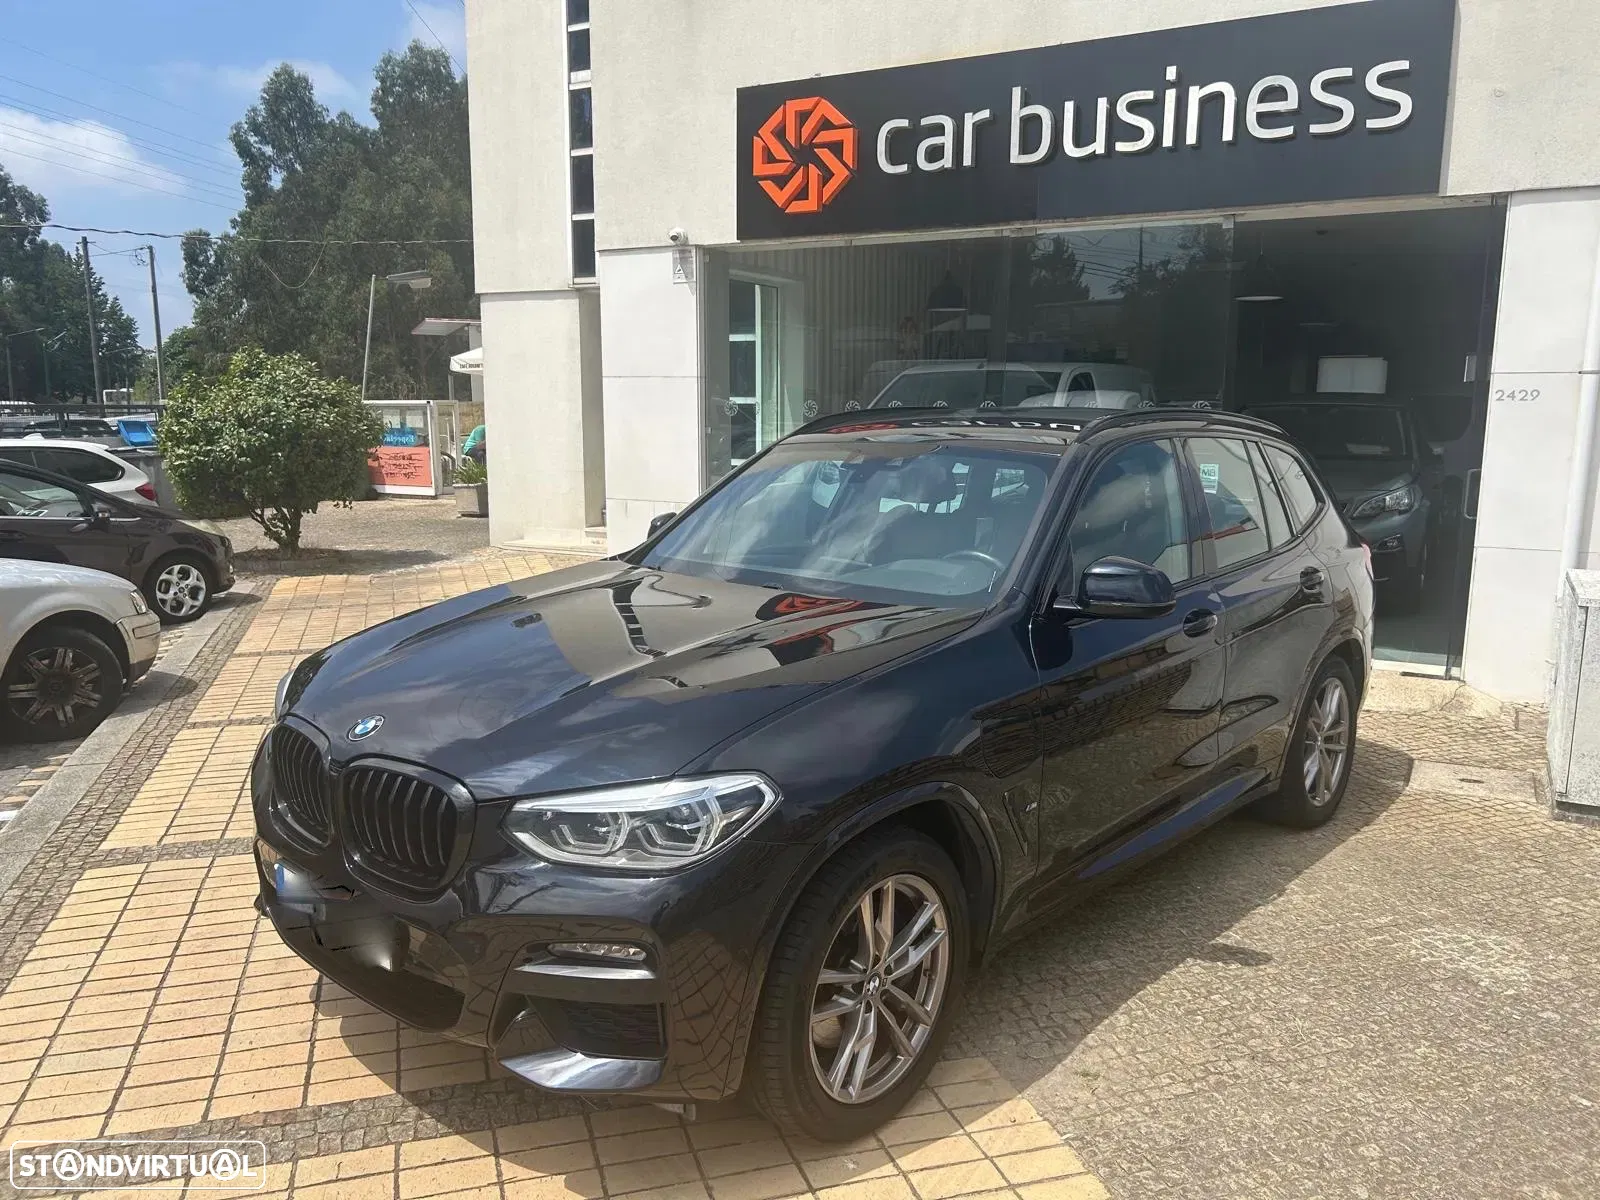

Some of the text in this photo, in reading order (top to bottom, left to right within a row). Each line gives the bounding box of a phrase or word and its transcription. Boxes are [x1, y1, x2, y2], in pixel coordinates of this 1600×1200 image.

[876, 59, 1414, 175] car business
[1495, 388, 1541, 401] 2429
